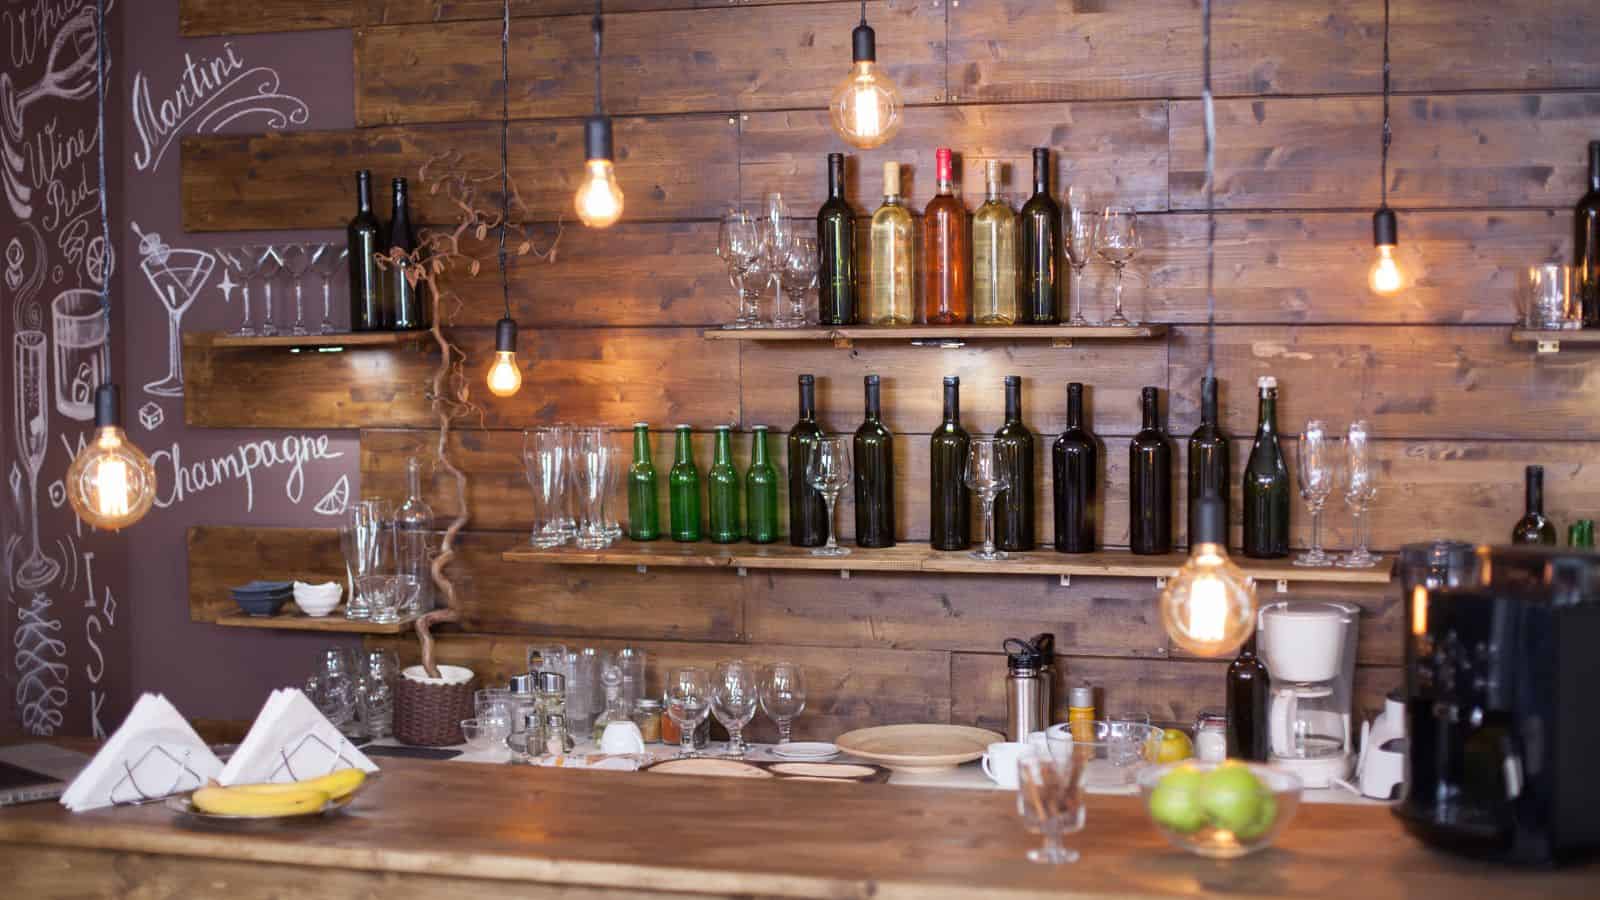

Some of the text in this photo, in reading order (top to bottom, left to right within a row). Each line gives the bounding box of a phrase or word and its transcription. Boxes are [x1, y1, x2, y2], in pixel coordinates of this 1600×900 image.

[133, 41, 244, 171] Martini
[24, 116, 98, 190] Wine
[42, 160, 99, 232] Red
[149, 434, 344, 513] Champagne
